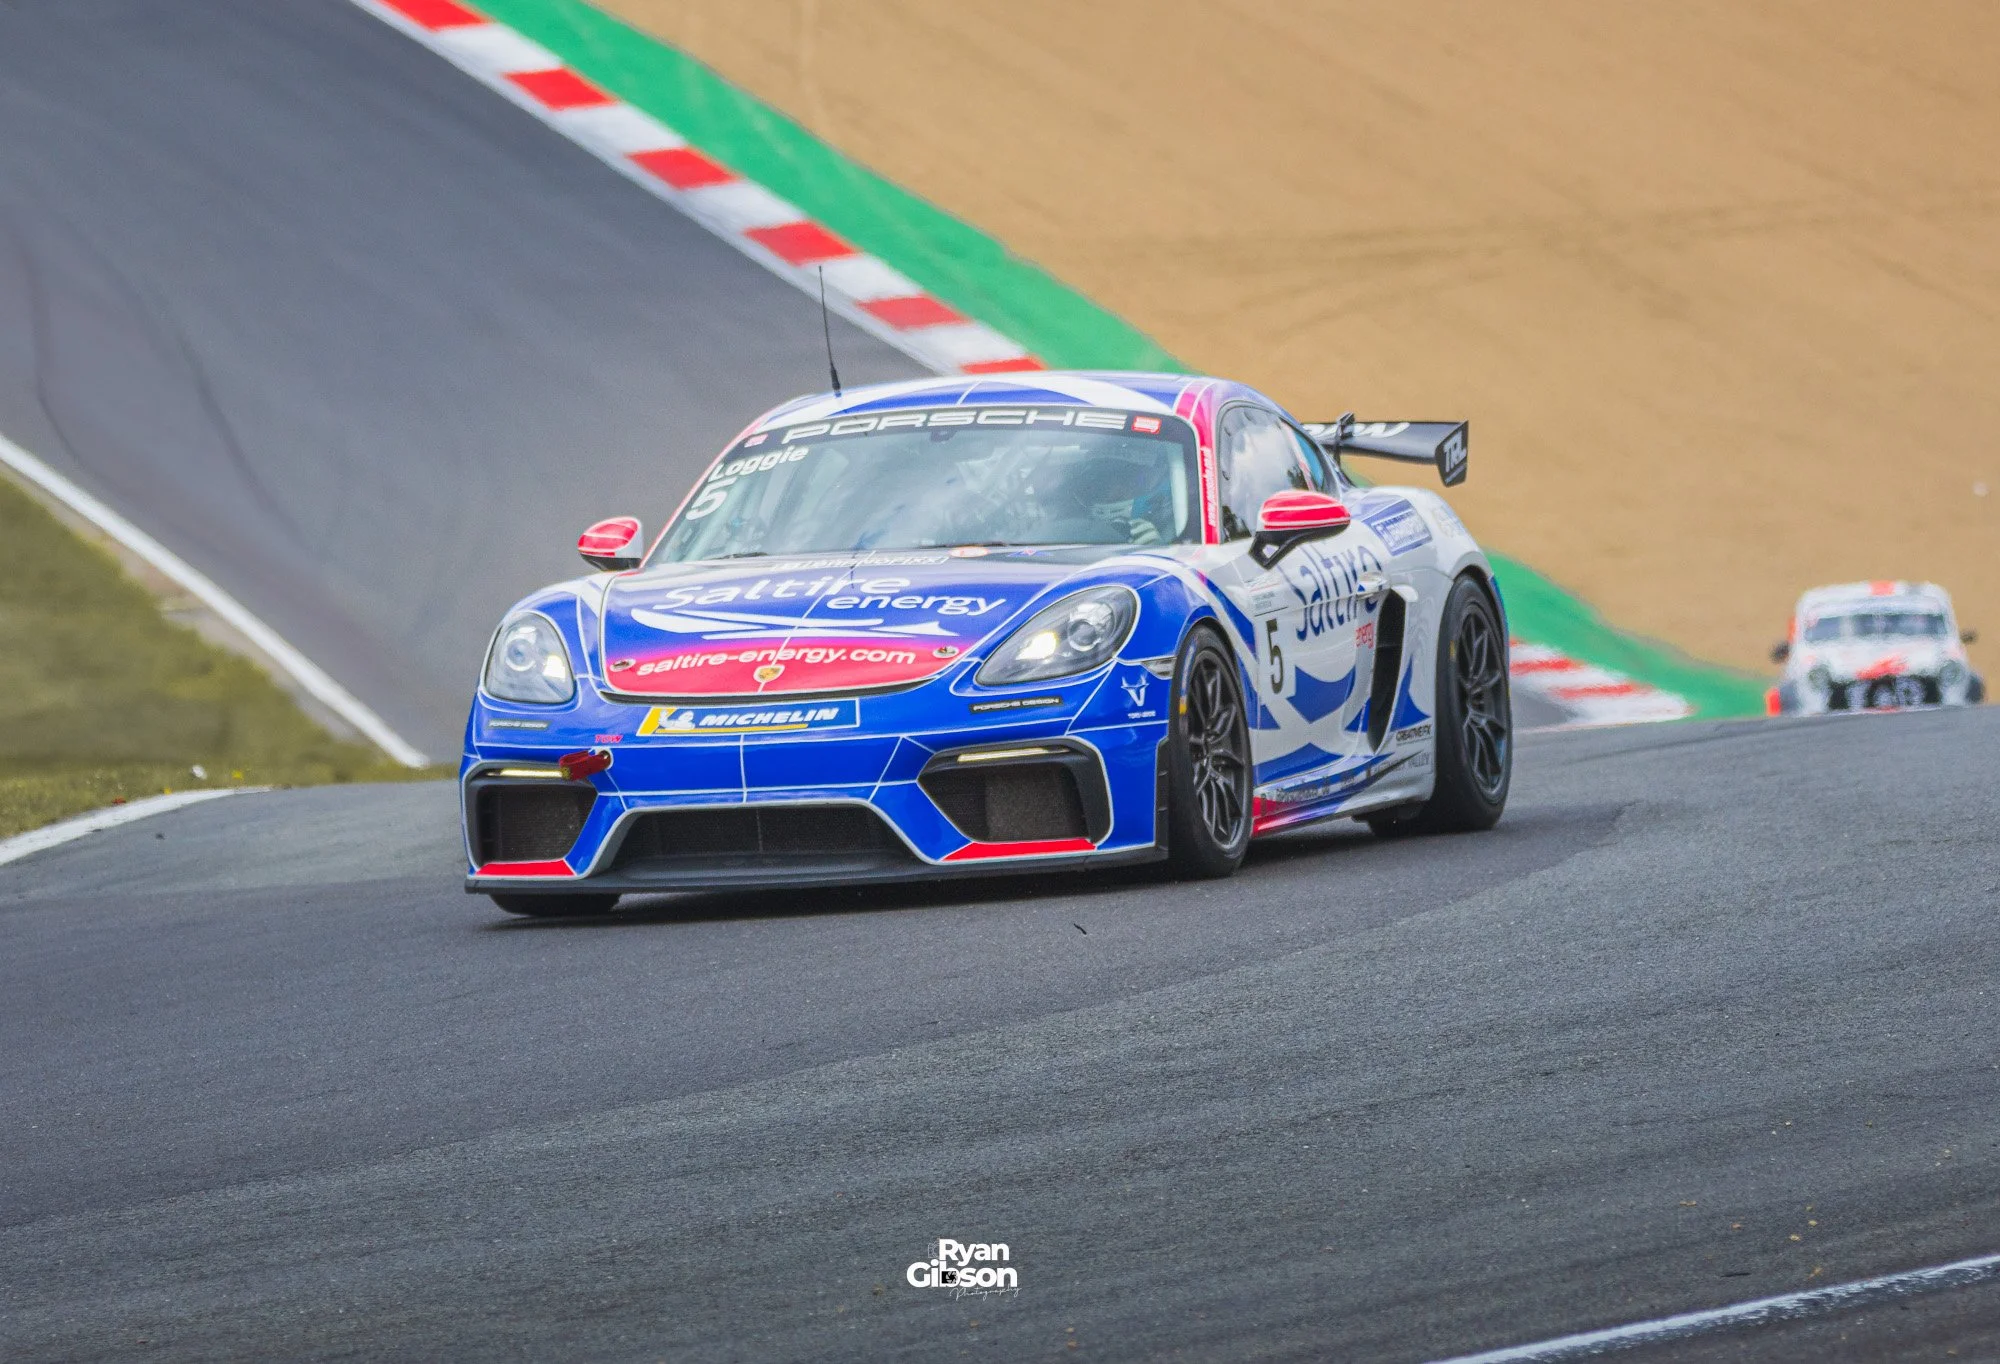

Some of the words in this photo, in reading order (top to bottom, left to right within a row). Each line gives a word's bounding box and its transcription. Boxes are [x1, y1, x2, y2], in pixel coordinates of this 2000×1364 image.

[781, 410, 1128, 445] PORSCHE
[708, 445, 809, 483] Loggie
[685, 476, 737, 521] 5
[826, 595, 1006, 616] energy
[637, 647, 917, 676] saltire-energy.com
[1265, 618, 1284, 695] 5
[699, 707, 840, 727] MICHELIN
[595, 734, 624, 744] TOW
